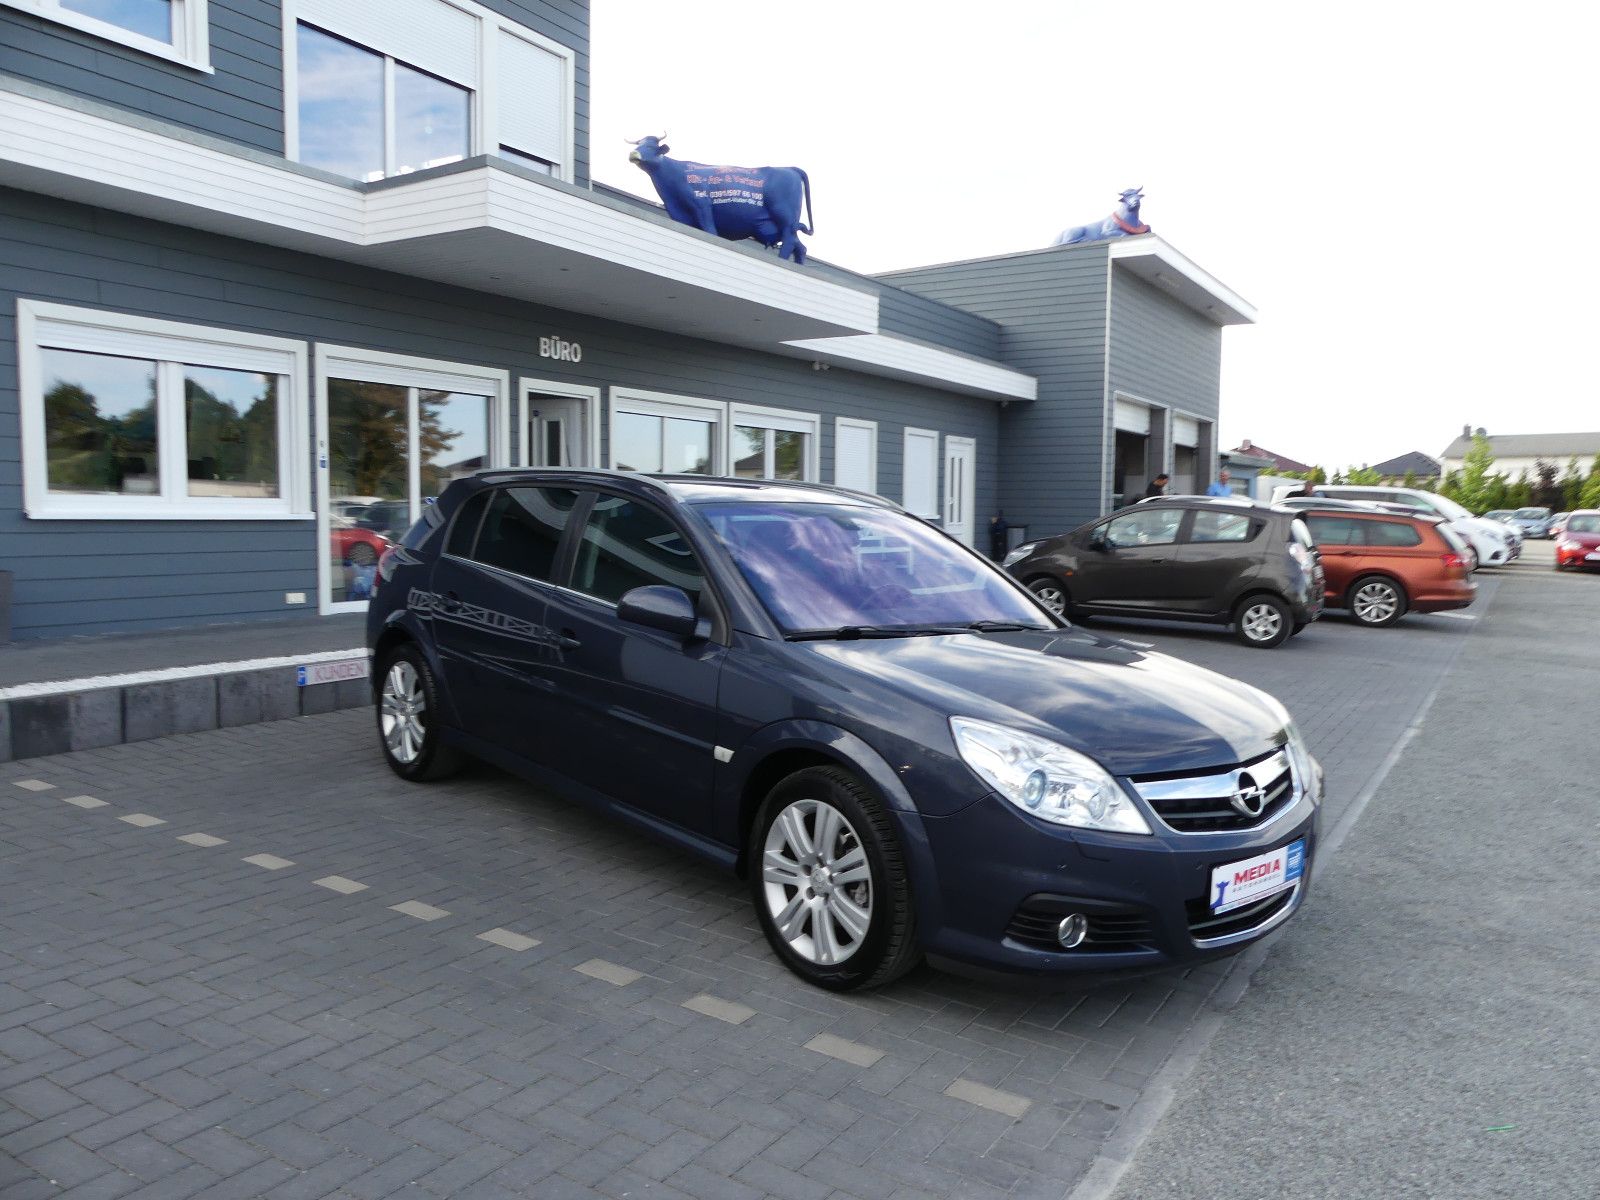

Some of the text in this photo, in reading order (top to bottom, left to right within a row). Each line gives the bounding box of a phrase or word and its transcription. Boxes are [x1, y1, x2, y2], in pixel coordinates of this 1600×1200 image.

[694, 190, 708, 198] Tel.
[539, 335, 582, 363] BÜRO
[314, 661, 363, 682] KUNDEN
[1234, 858, 1281, 886] MEDIA
